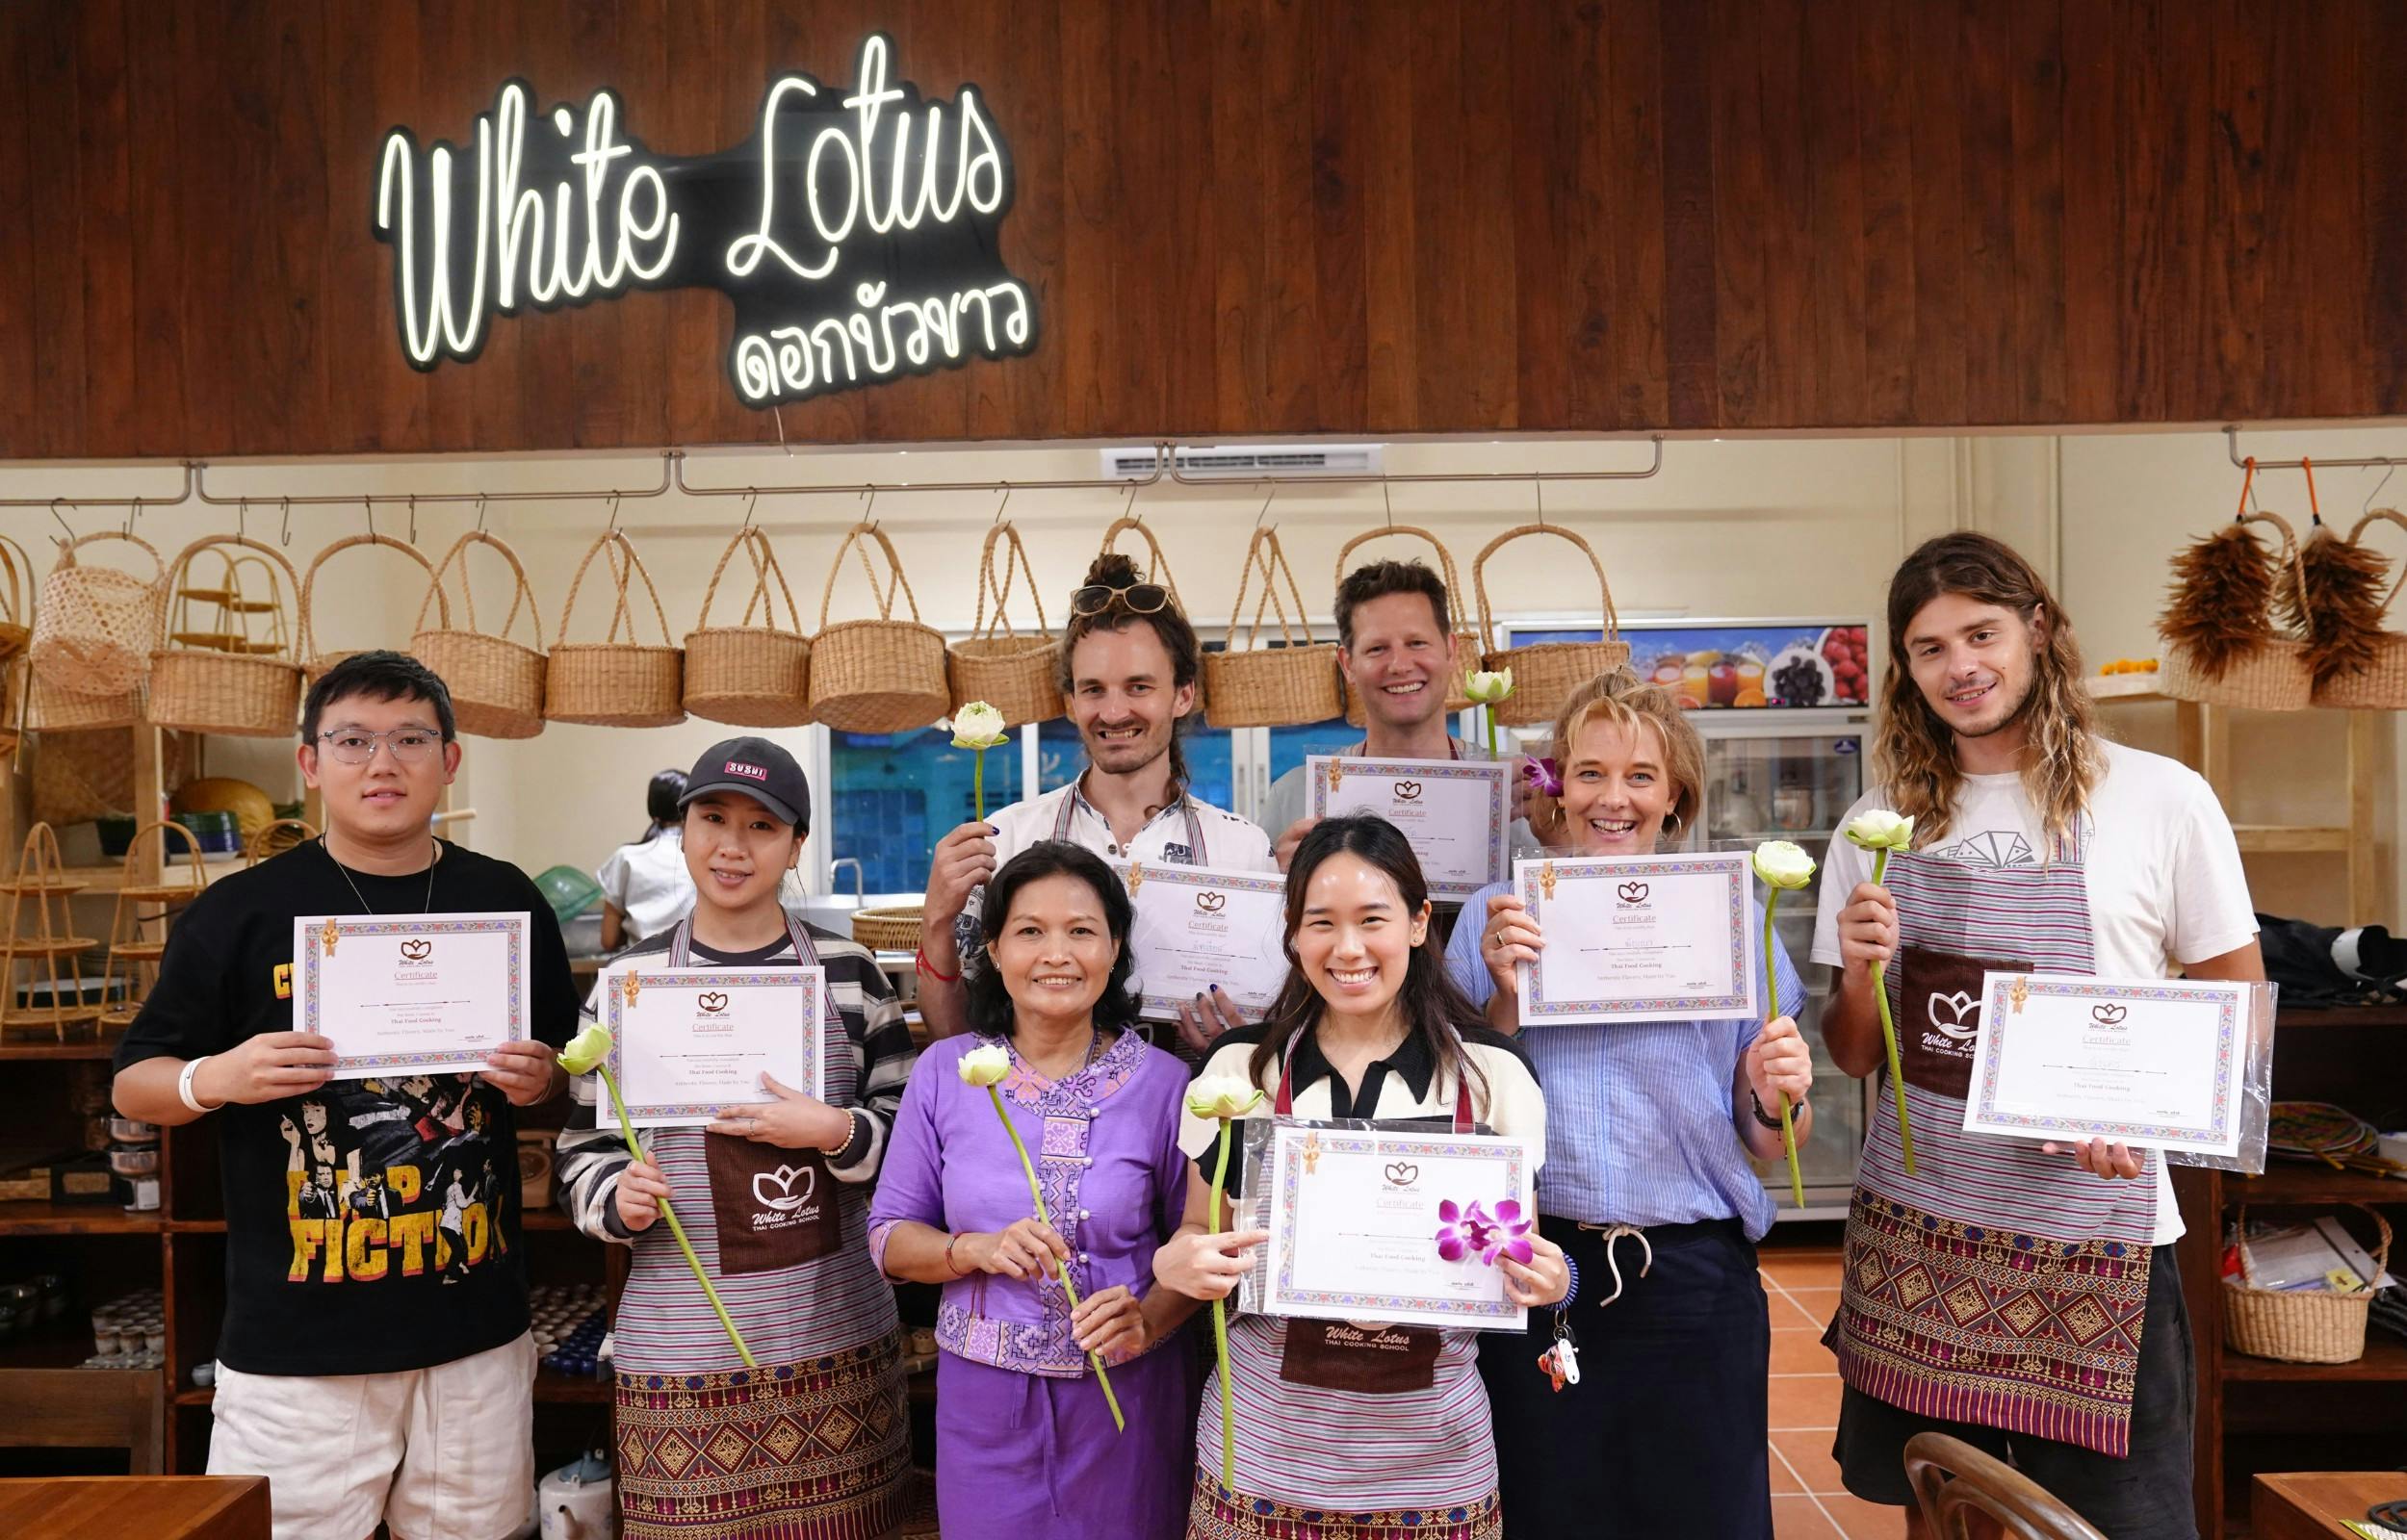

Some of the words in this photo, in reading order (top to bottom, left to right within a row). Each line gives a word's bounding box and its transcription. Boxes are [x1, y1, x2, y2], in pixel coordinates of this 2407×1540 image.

[379, 84, 679, 363] White
[727, 35, 1002, 280] Lotus
[737, 280, 1029, 399] ดอกบัวขาว
[729, 762, 764, 777] SUSHI
[1388, 808, 1427, 817] Certificate
[1188, 920, 1229, 932] Certificate
[1612, 914, 1656, 924] Certificate
[394, 970, 439, 980] Certificate
[692, 1023, 734, 1032] Certificate
[1921, 1032, 1953, 1048] White
[1921, 1044, 1934, 1053] THAI
[1935, 1047, 1963, 1058] COOKING
[751, 1210, 787, 1225] White
[791, 1205, 820, 1219] Lotus
[770, 1219, 796, 1229] COOKING
[798, 1214, 820, 1223] SCHOOL
[1325, 1325, 1364, 1342] White
[1370, 1329, 1411, 1345] Lotus
